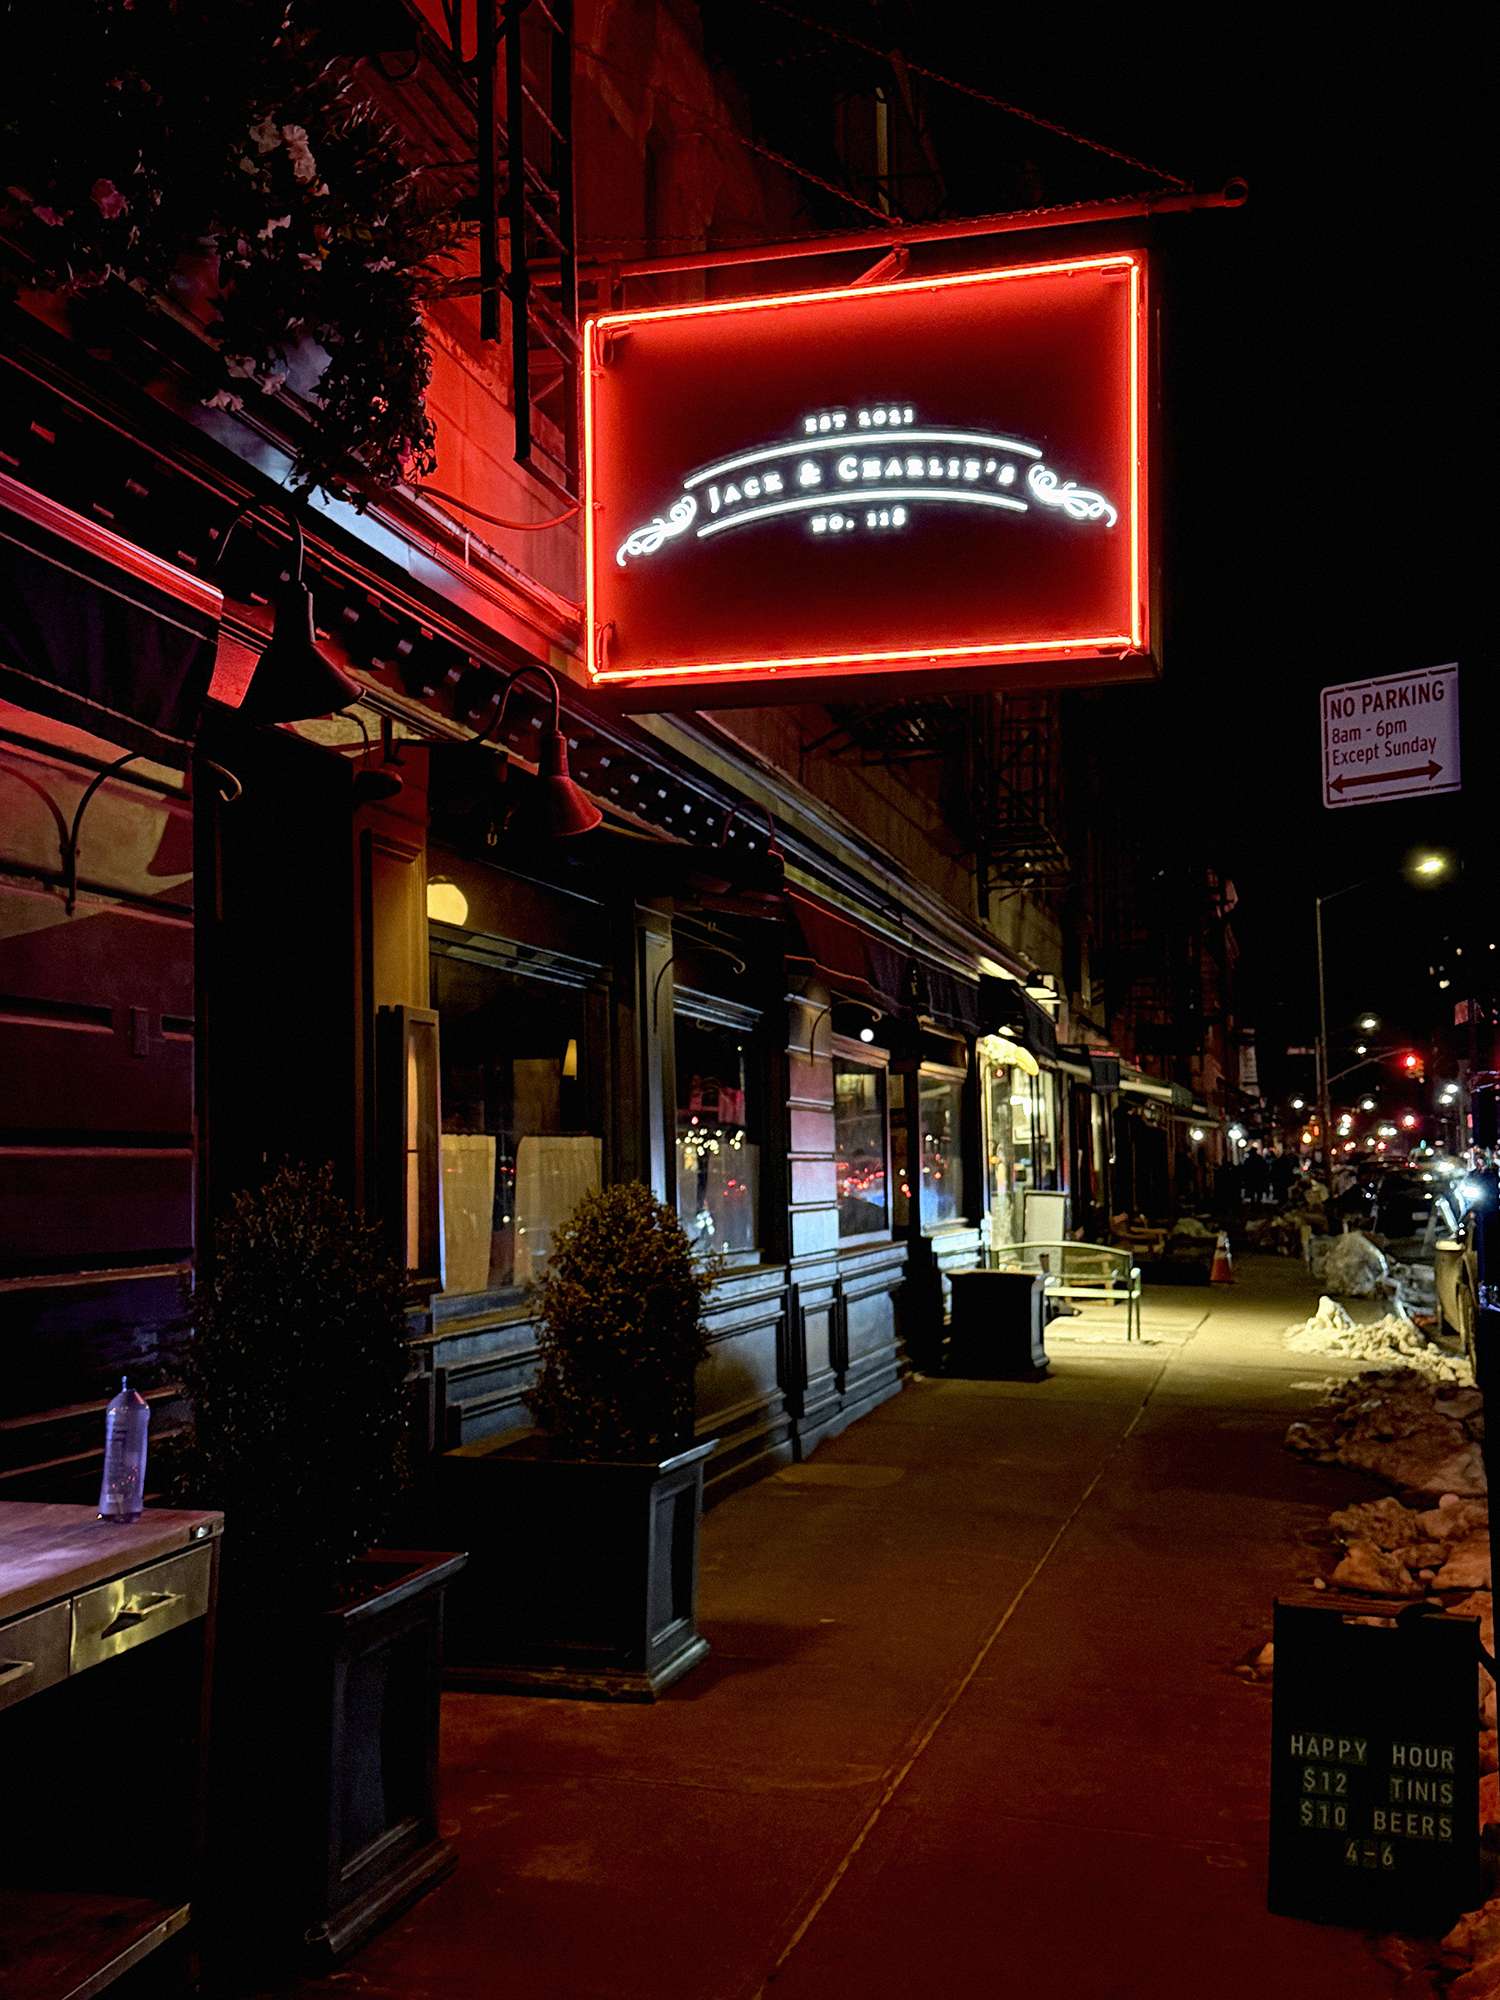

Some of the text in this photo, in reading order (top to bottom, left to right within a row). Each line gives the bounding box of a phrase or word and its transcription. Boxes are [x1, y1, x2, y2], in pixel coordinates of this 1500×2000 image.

[804, 407, 914, 433] EST 2021
[799, 462, 822, 485] &
[866, 508, 906, 528] 118
[1331, 680, 1444, 720] NO PARKING
[1333, 728, 1361, 744] 8am
[1376, 720, 1407, 738] 6pm
[1333, 736, 1437, 766] Except Sunday
[1291, 1734, 1454, 1769] HAPPY HOUR
[1304, 1769, 1453, 1805] $12 TINIS
[1301, 1802, 1452, 1838] $10 BEERS
